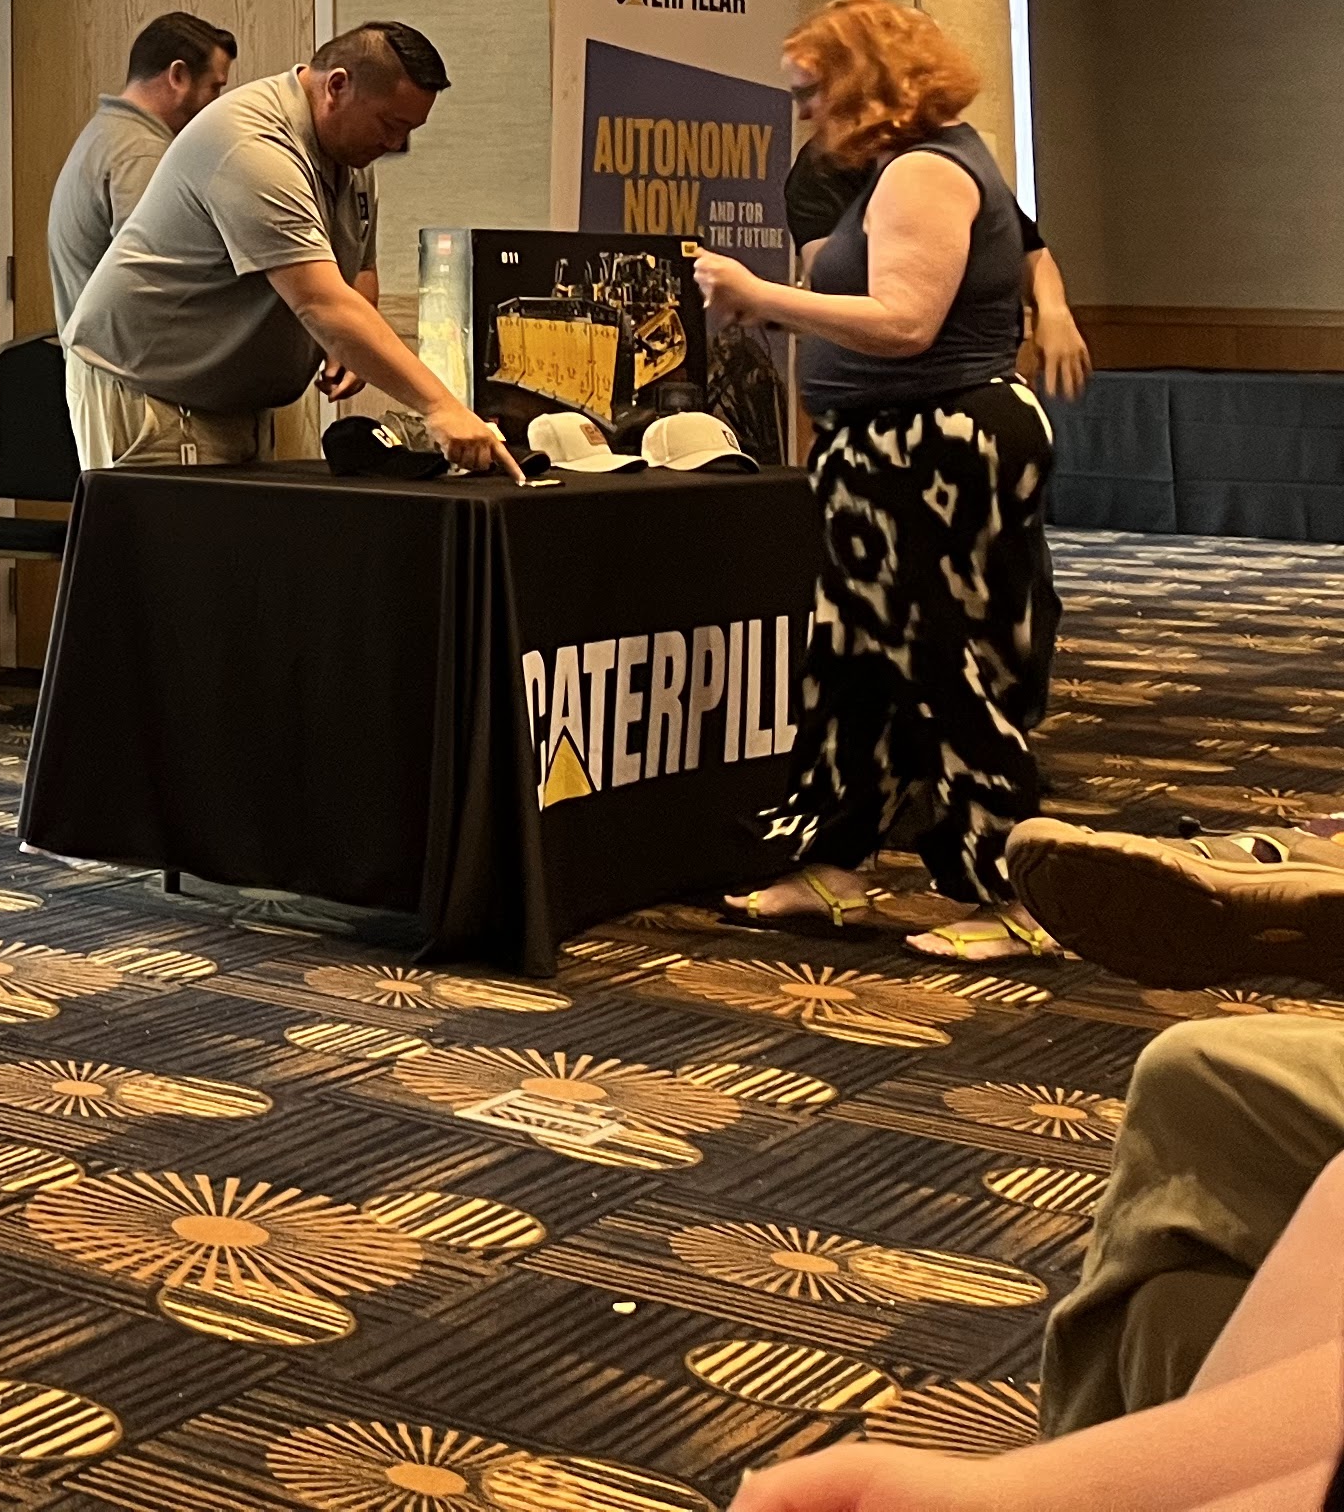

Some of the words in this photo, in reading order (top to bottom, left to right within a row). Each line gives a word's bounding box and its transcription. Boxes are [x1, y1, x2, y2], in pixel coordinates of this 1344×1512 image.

[593, 115, 773, 181] AUTONOMY
[709, 200, 735, 224] AND
[738, 202, 764, 224] FOR
[709, 225, 734, 248] THE
[736, 227, 785, 249] FUTURE
